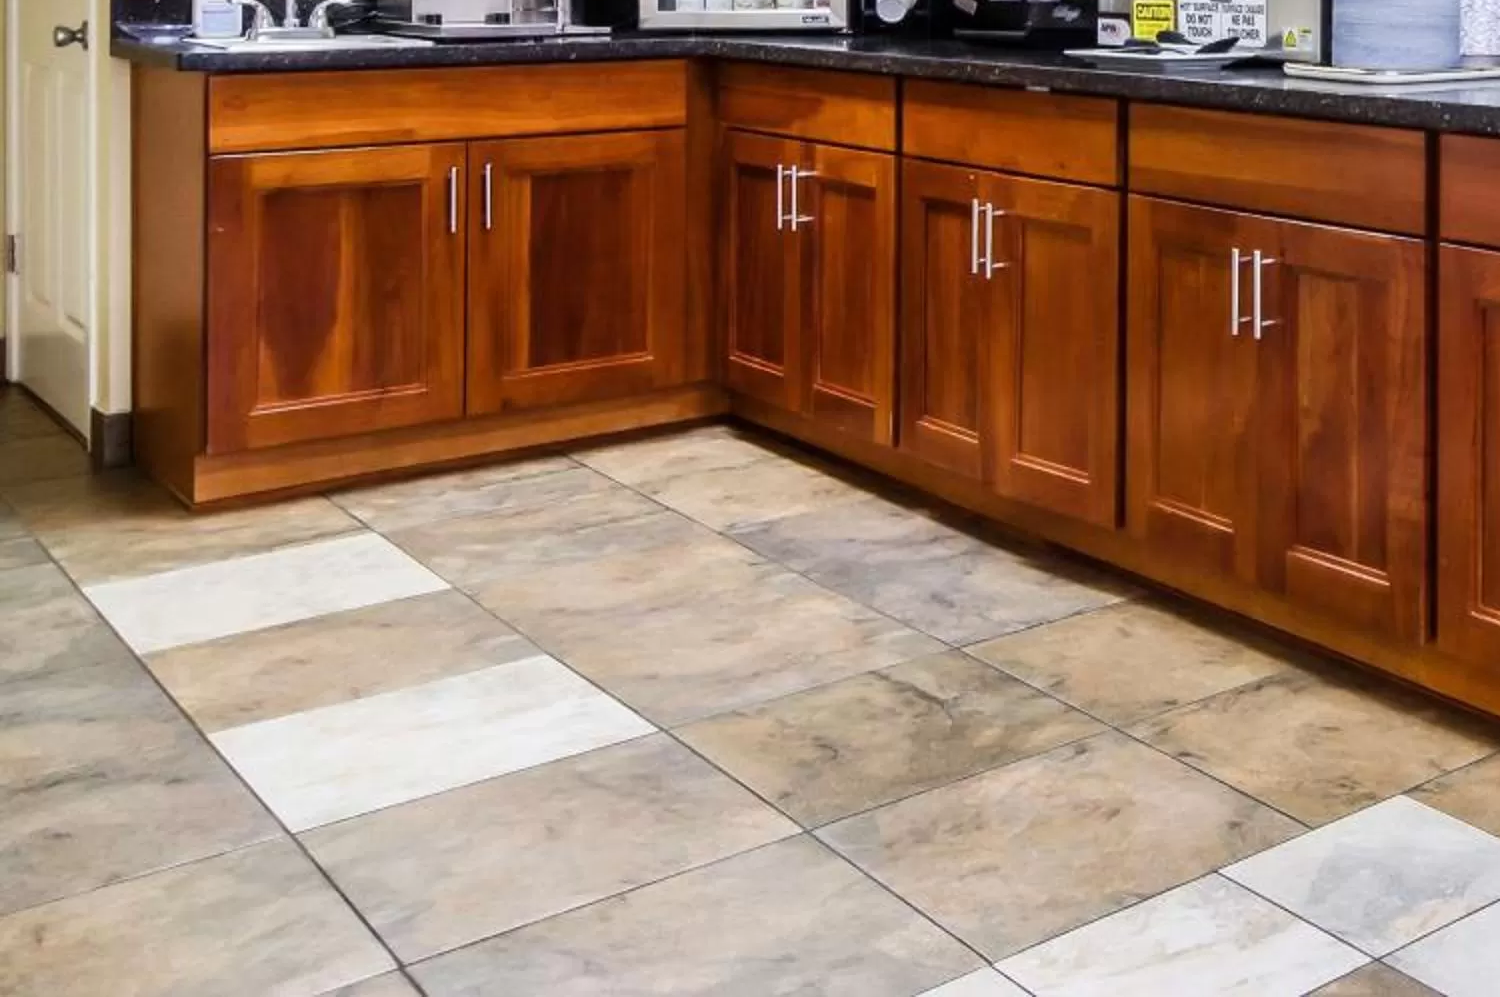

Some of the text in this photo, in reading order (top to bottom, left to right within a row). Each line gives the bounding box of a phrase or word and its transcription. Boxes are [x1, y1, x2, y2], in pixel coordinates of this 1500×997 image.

[1186, 13, 1213, 25] DO NOT
[1187, 26, 1213, 37] TOUCH
